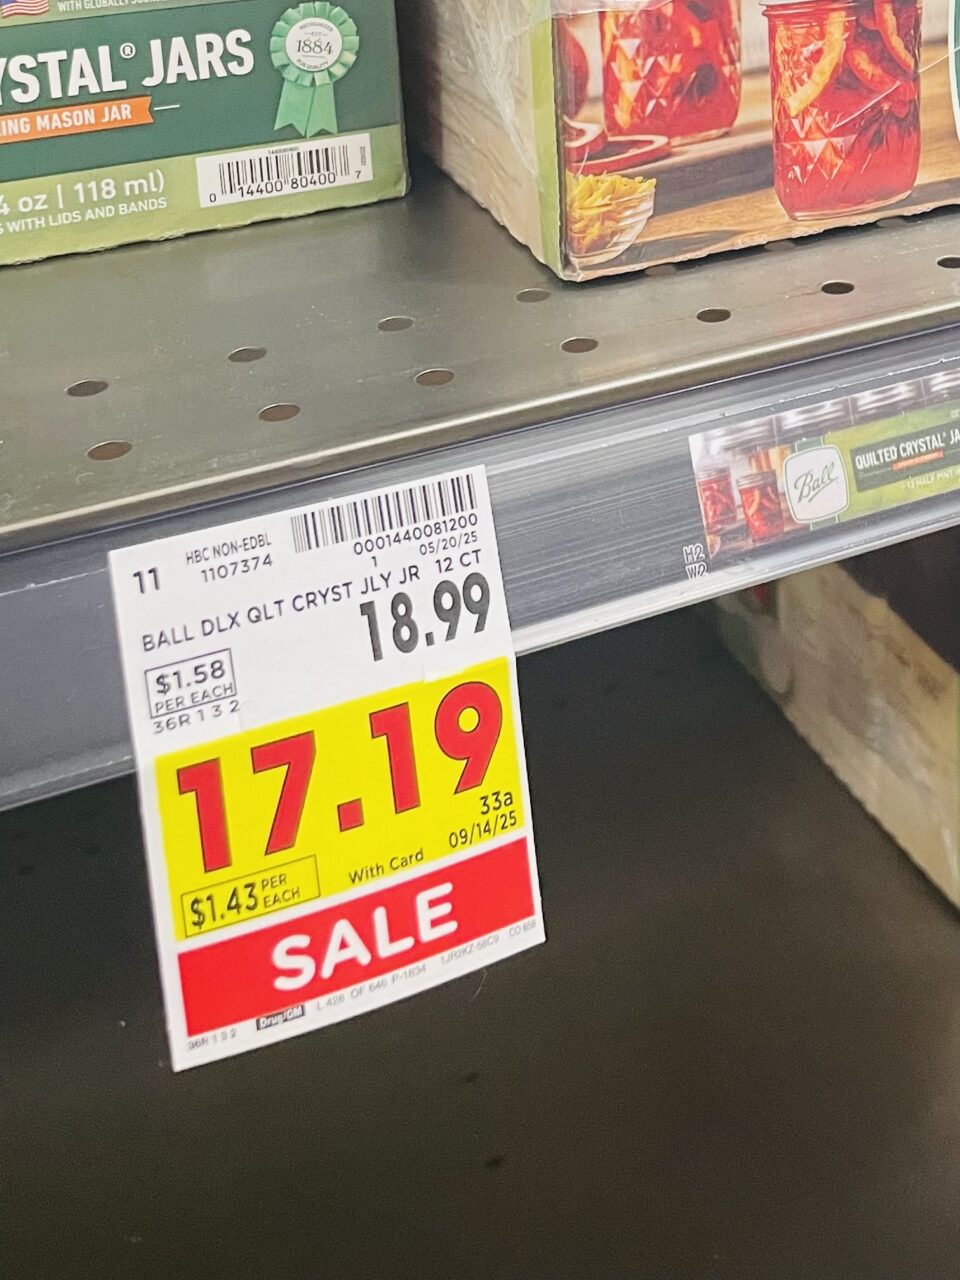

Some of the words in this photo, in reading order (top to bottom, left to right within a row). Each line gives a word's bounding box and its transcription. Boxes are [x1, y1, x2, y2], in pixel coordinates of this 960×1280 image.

[58, 0, 82, 12] WITH
[141, 29, 254, 87] JARS
[296, 36, 334, 55] 1884
[37, 108, 95, 131] MASON
[101, 104, 132, 122] JAR
[18, 194, 48, 212] oz
[74, 178, 116, 203] 118
[124, 170, 164, 196] ml)
[238, 180, 283, 197] 14400
[291, 172, 336, 189] 80400
[7, 217, 45, 233] WITH
[49, 211, 81, 226] LIDS
[85, 205, 115, 221] AND
[119, 197, 167, 215] BANDS
[855, 446, 898, 469] QUILTED
[794, 462, 839, 503] Ball
[186, 548, 210, 565] HBC
[213, 533, 272, 559] NON-EDBL
[353, 513, 478, 555] 0001440081200
[419, 531, 478, 556] 05/20/25
[133, 567, 161, 594] 11
[201, 554, 273, 583] 1107374
[142, 624, 195, 652] BALL
[201, 611, 241, 637] DLX
[247, 599, 284, 624] QLT
[292, 582, 352, 612] CRYST
[361, 571, 392, 595] JLY
[399, 565, 420, 585] JR
[435, 557, 453, 574] 12
[459, 549, 482, 567] CT
[359, 572, 490, 662] 18.99
[156, 659, 225, 696] $1.58
[155, 696, 185, 714] PER
[190, 682, 233, 704] EACH
[153, 713, 191, 735] 36R
[176, 681, 502, 874] 17.19
[480, 791, 514, 816] 33a
[449, 810, 517, 849] 09/14/25
[261, 874, 288, 890] PER
[348, 864, 385, 885] With
[390, 848, 425, 871] Card
[190, 882, 259, 930] $1.43
[263, 886, 300, 909] EACH
[272, 882, 459, 991] SALE
